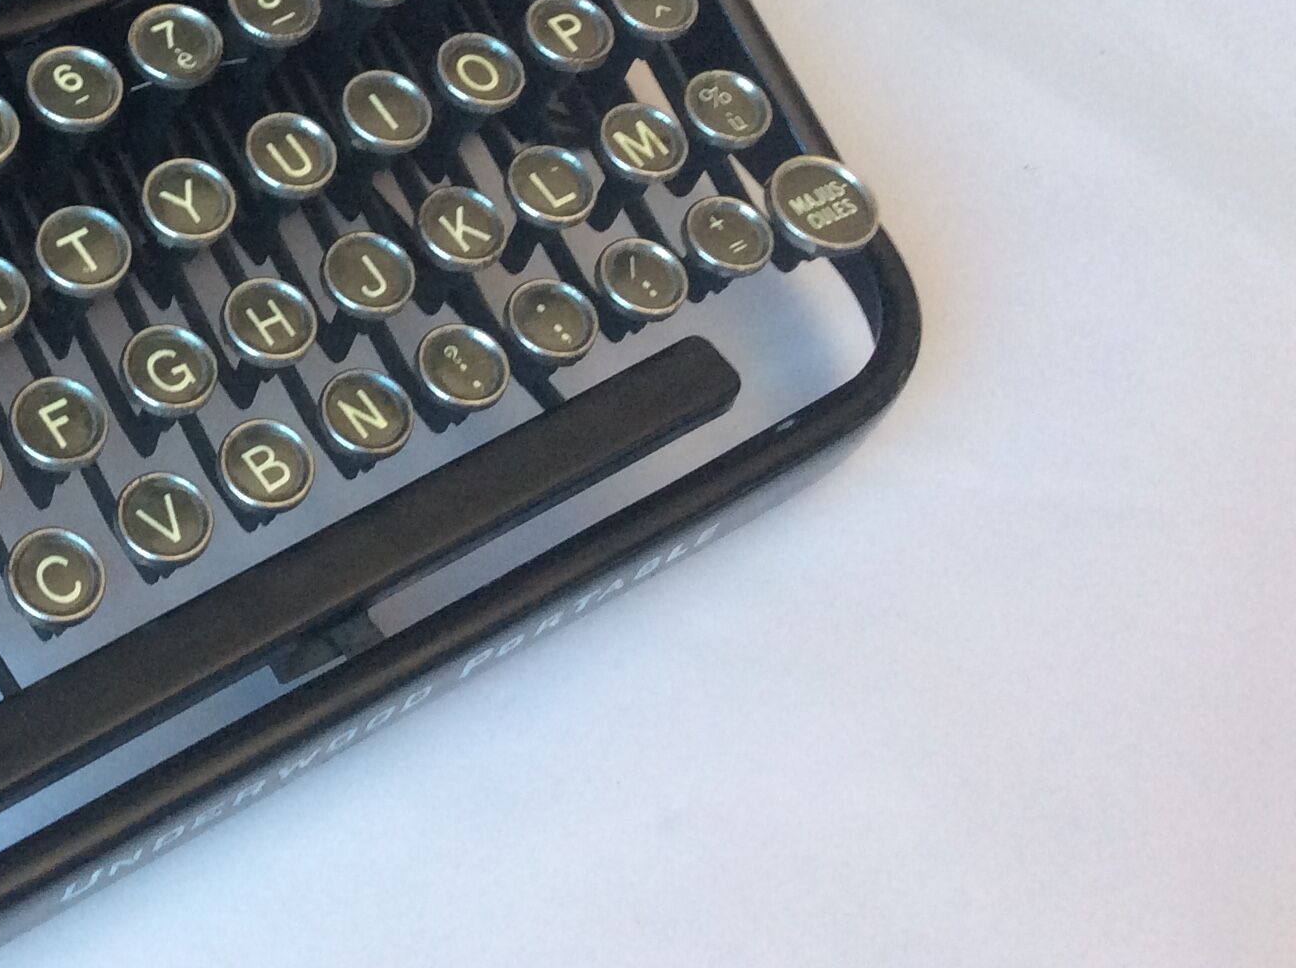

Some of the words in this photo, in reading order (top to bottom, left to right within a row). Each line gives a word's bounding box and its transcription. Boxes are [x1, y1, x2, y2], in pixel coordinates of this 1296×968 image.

[150, 20, 174, 49] 7
[548, 13, 582, 52] P
[53, 64, 83, 92] 6
[456, 54, 499, 92] O
[369, 94, 399, 130] I
[698, 86, 733, 109] %
[266, 134, 313, 178] U
[612, 120, 669, 167] M
[159, 179, 201, 224] Y
[529, 172, 577, 208] L
[56, 227, 98, 272] T
[438, 206, 491, 253] K
[361, 255, 387, 298] J
[246, 299, 296, 347] H
[146, 349, 196, 393] G
[38, 398, 69, 449] F
[337, 389, 388, 439] N
[241, 445, 291, 494] B
[136, 493, 182, 544] V
[36, 555, 82, 604] C
[60, 686, 432, 902] UNDERWOOD
